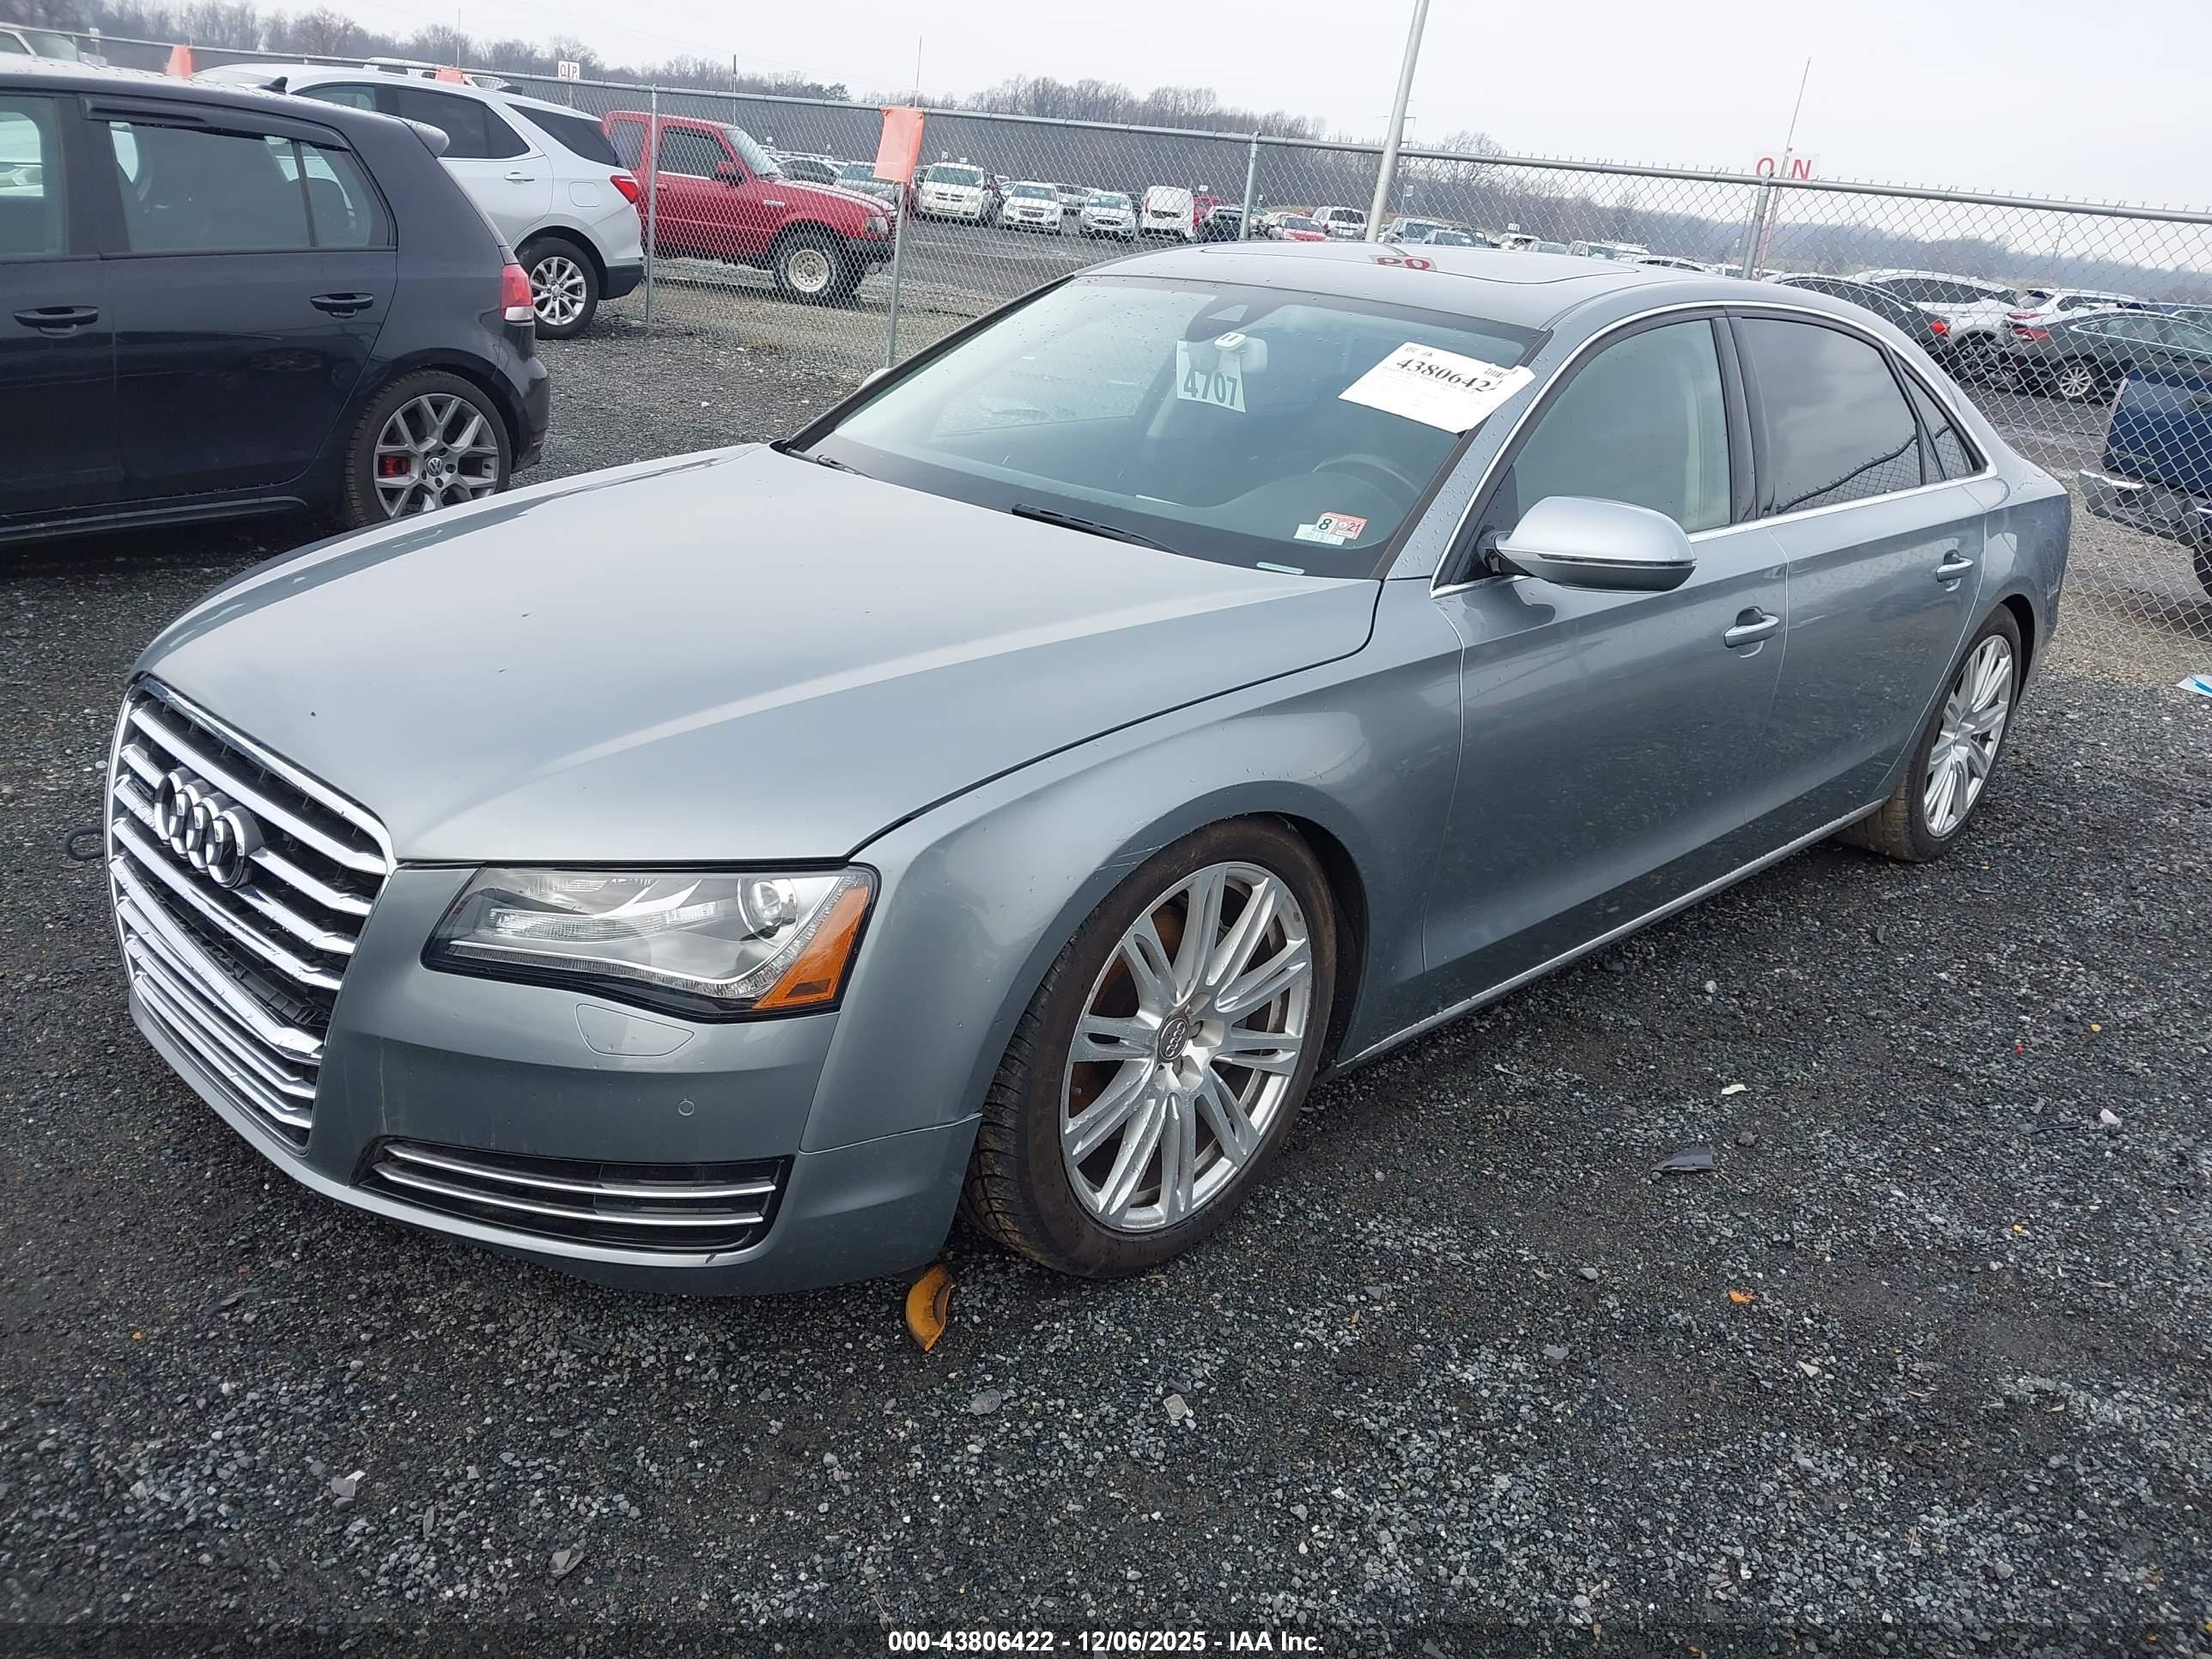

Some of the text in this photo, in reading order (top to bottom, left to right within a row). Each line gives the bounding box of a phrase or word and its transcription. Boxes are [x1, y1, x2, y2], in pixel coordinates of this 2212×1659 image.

[1791, 159, 1812, 179] N
[1183, 367, 1237, 406] 4707
[1318, 518, 1361, 532] 8 21
